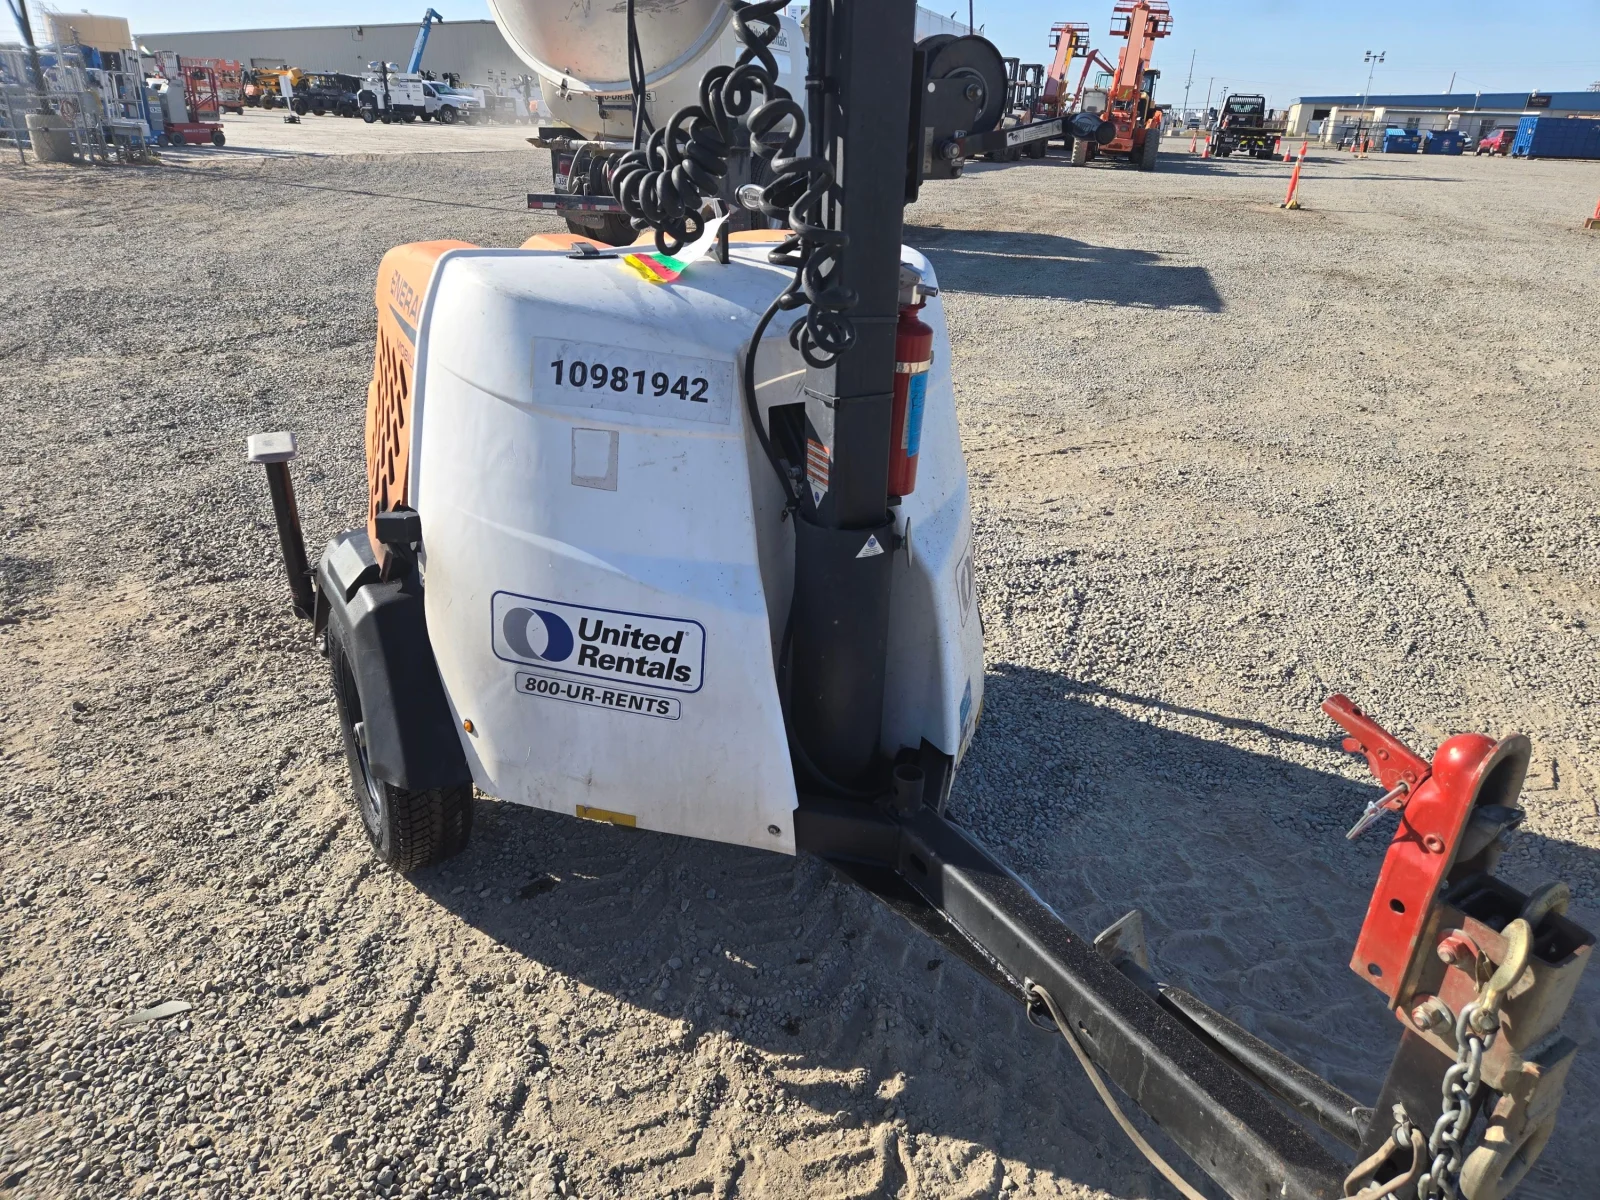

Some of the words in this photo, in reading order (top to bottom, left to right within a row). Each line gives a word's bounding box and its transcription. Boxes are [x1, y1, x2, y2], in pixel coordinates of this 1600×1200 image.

[551, 360, 709, 403] 10981942
[578, 617, 685, 654] United
[577, 644, 692, 683] Rentals
[525, 677, 671, 715] 800-UR-RENTS
